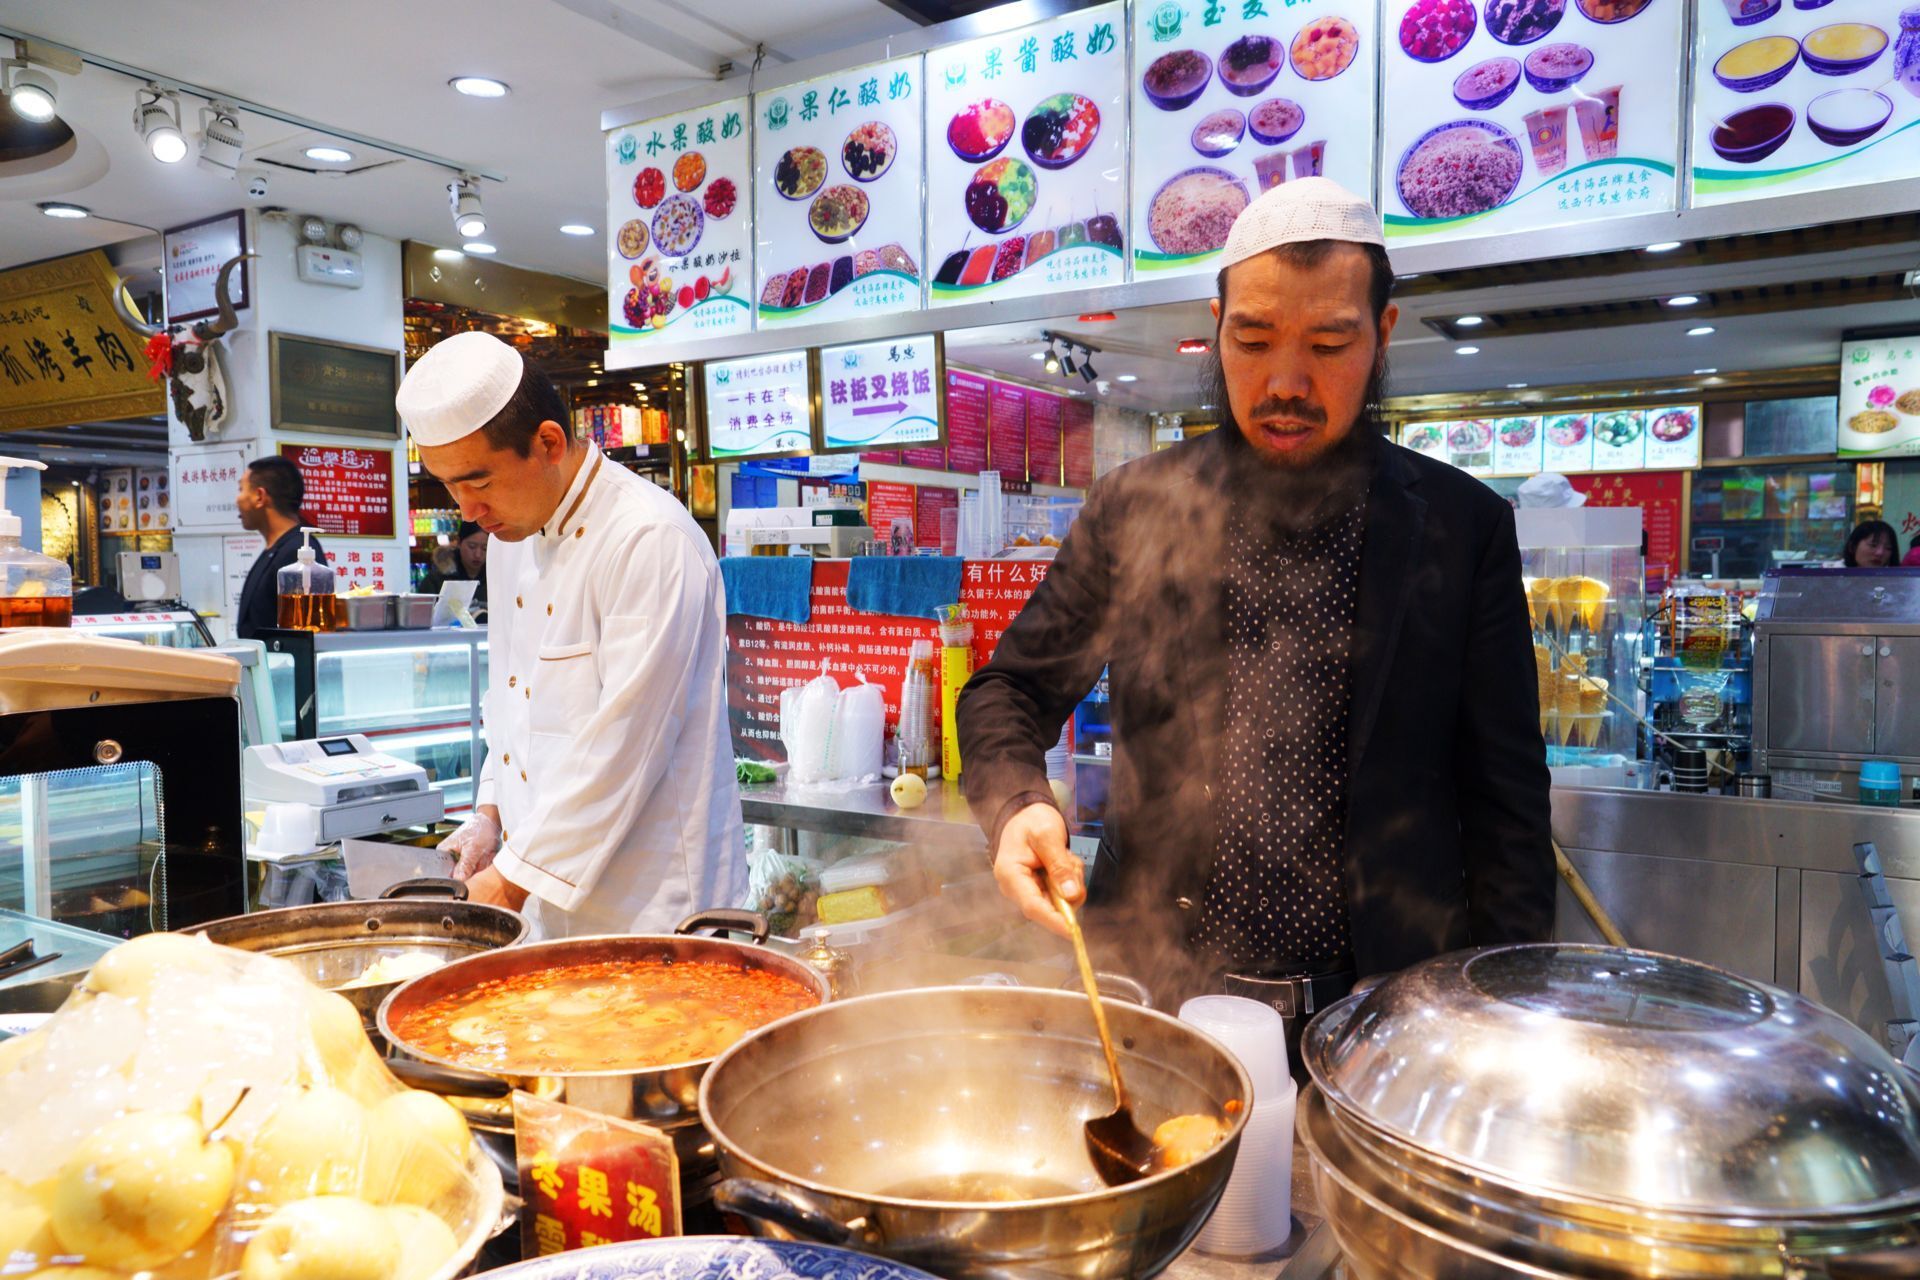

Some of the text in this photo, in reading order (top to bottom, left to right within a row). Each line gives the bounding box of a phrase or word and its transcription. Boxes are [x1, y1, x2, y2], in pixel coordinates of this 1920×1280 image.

[799, 71, 911, 121] 果仁酸奶
[646, 112, 742, 157] 水果酸奶
[831, 368, 930, 404] 铁板叉烧饭
[729, 412, 793, 431] 消费全场
[299, 448, 374, 469] 温馨提示
[337, 566, 384, 577] 羊肉汤
[967, 564, 1047, 583] 有什么好
[960, 589, 1034, 600] 些久留于人体的废
